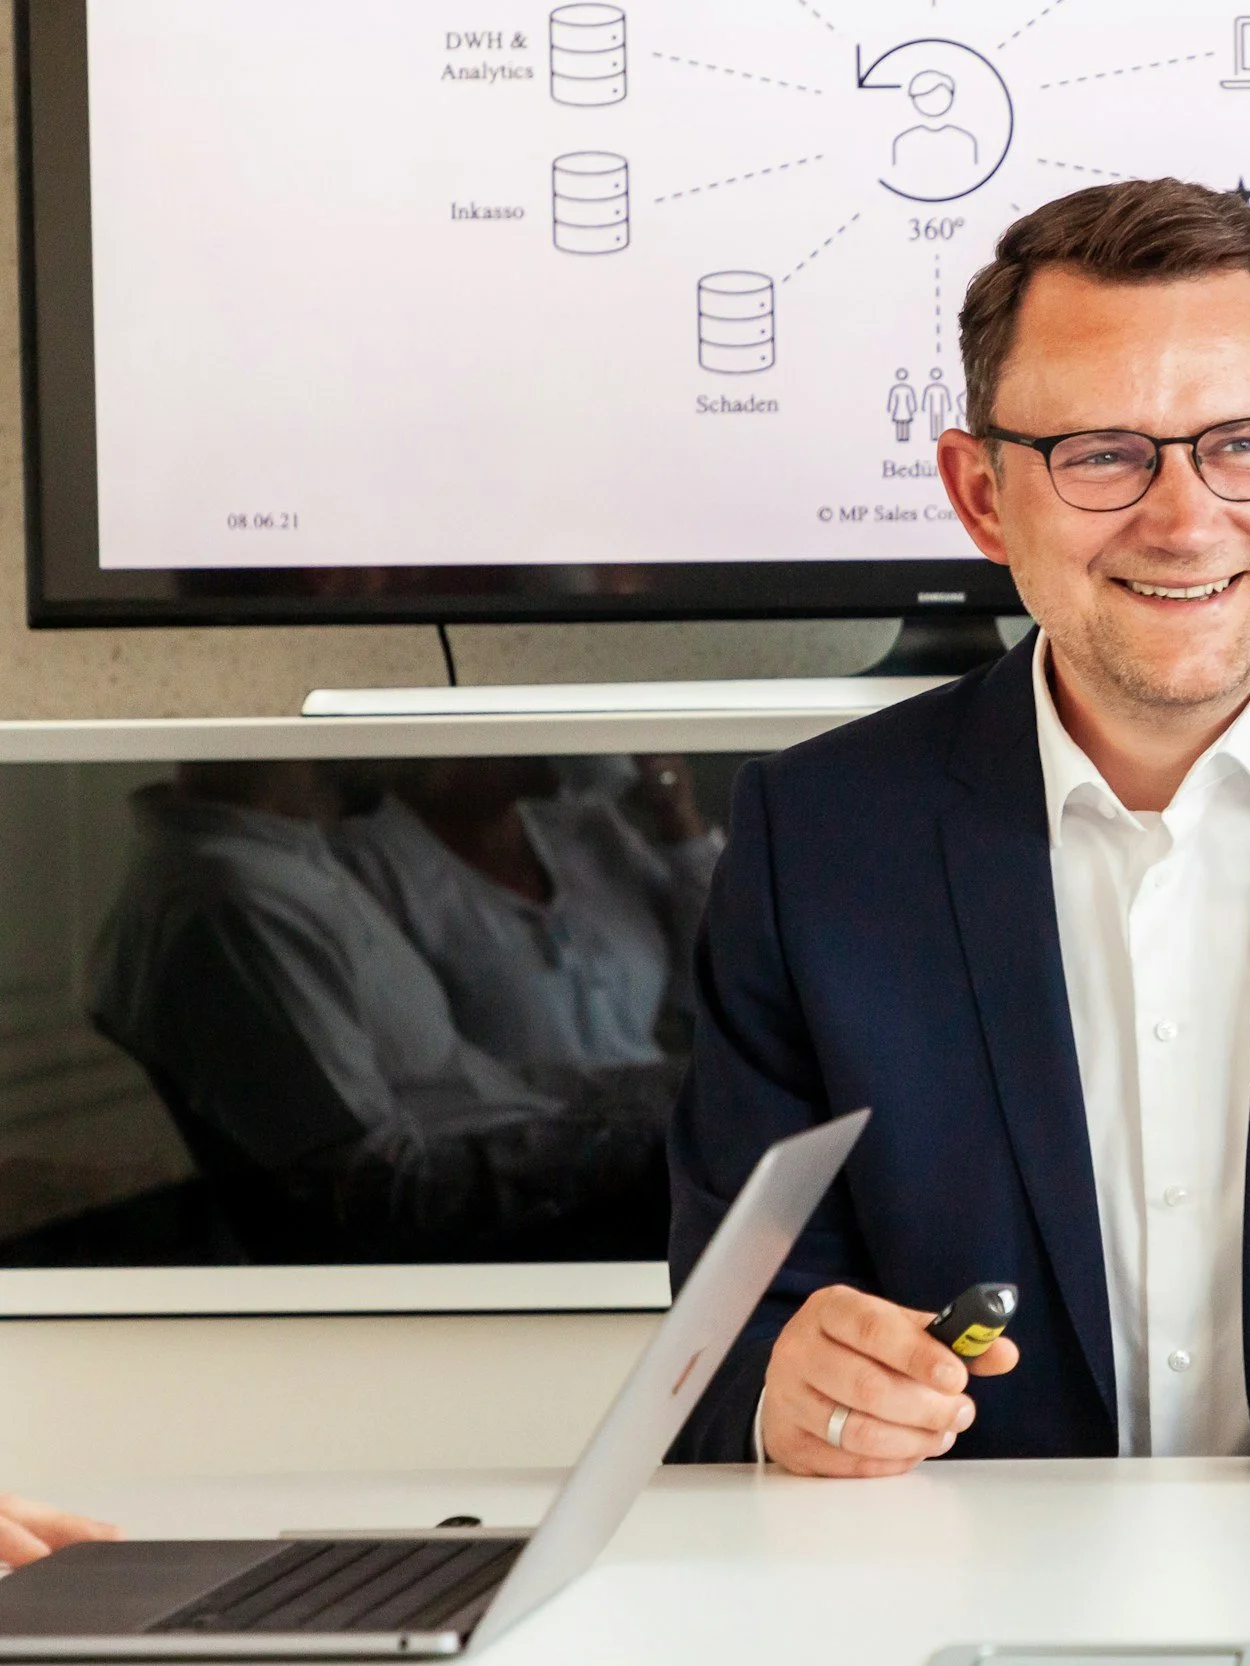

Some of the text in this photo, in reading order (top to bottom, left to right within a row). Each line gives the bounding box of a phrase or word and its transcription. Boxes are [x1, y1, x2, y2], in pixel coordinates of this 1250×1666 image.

[445, 32, 528, 50] DWH &
[441, 62, 534, 83] Analytics
[450, 202, 525, 221] Inkasso
[696, 393, 779, 414] Schaden
[227, 512, 299, 530] 08.06.21
[840, 506, 868, 521] MP
[874, 505, 917, 521] Sales
